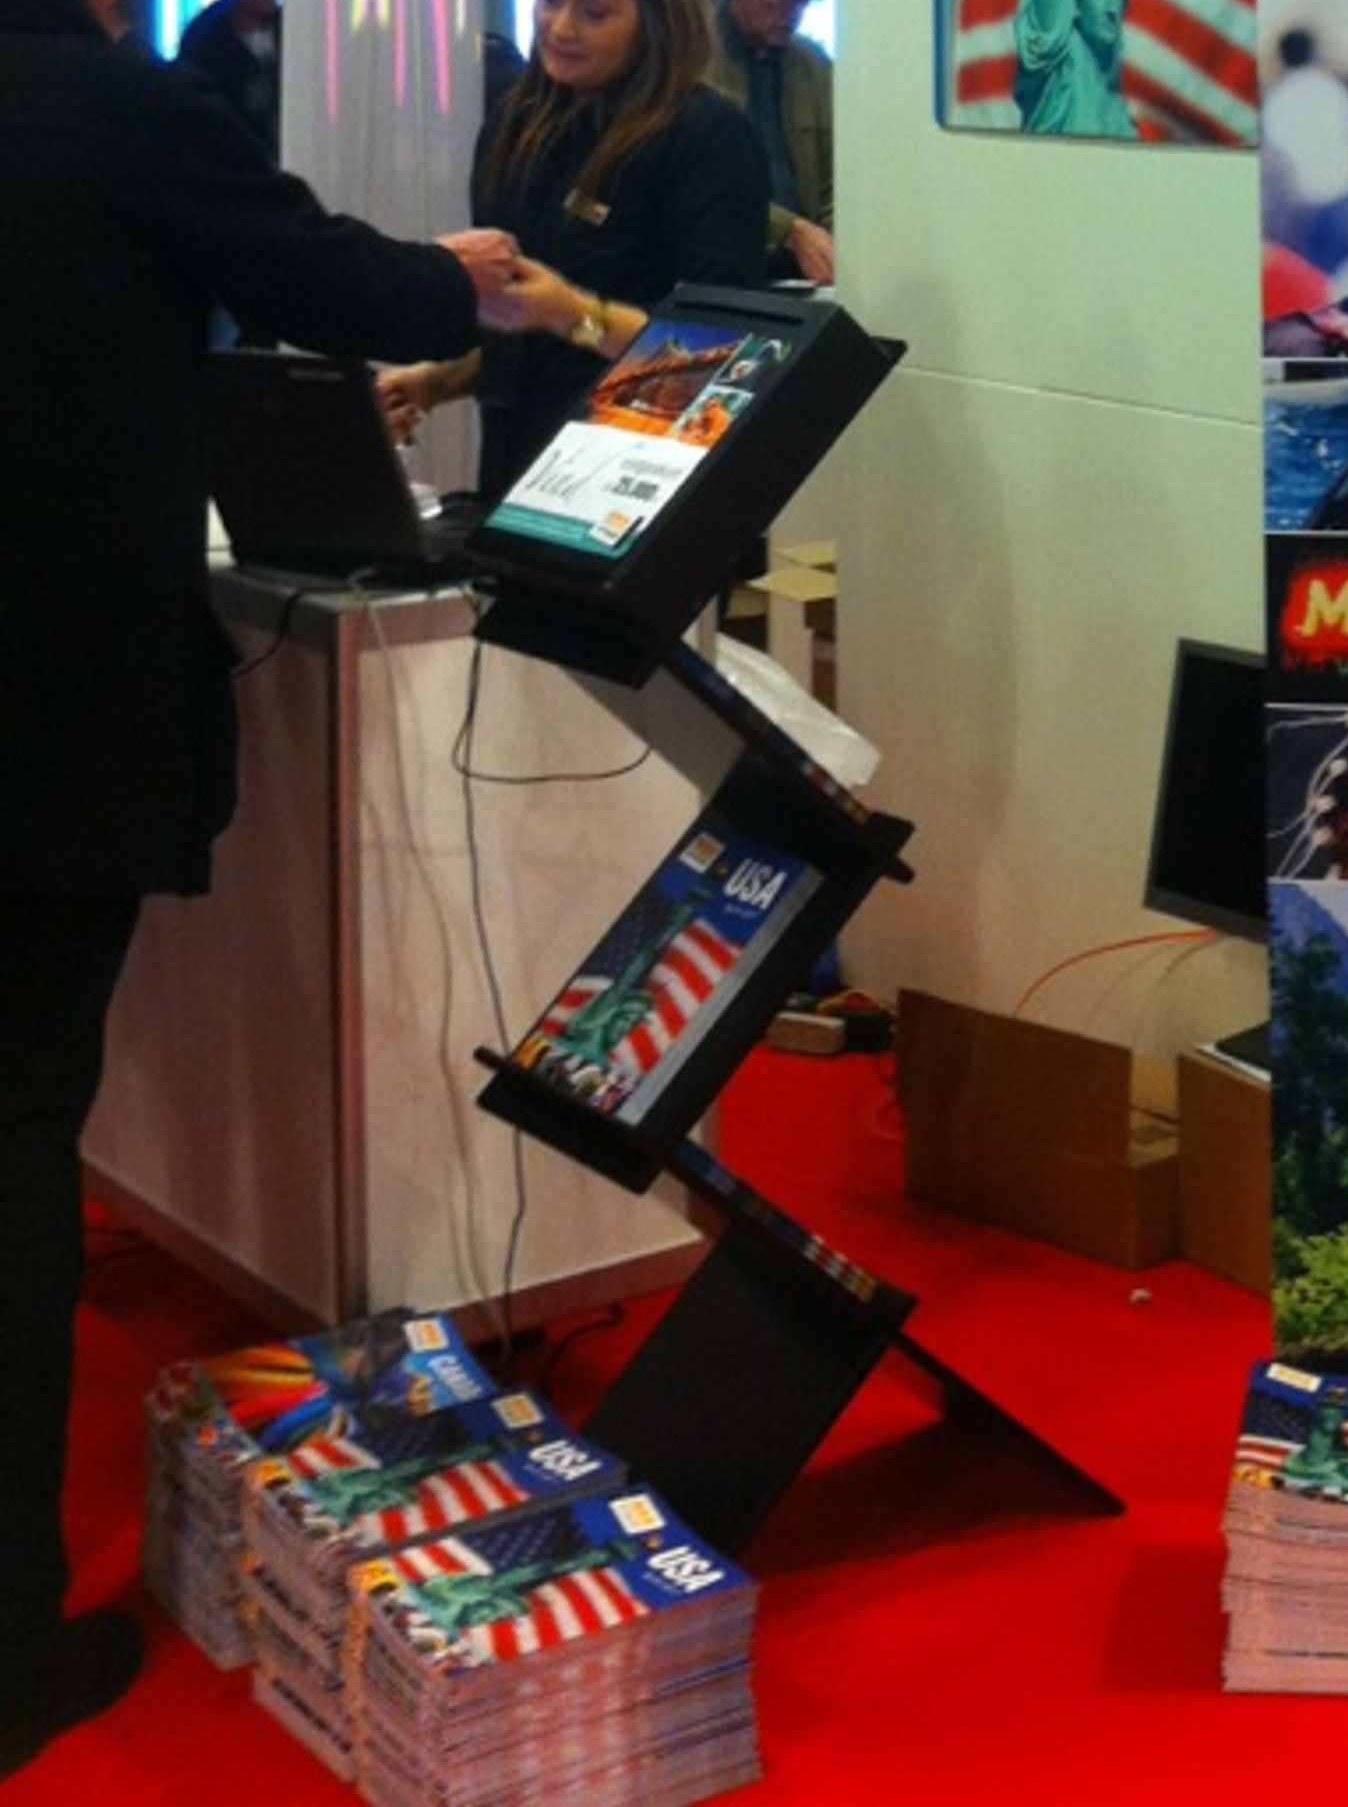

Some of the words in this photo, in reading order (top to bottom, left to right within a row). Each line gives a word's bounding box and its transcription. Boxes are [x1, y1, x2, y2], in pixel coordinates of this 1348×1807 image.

[722, 856, 790, 911] USA
[527, 1437, 603, 1483] USA
[645, 1545, 727, 1594] USA
